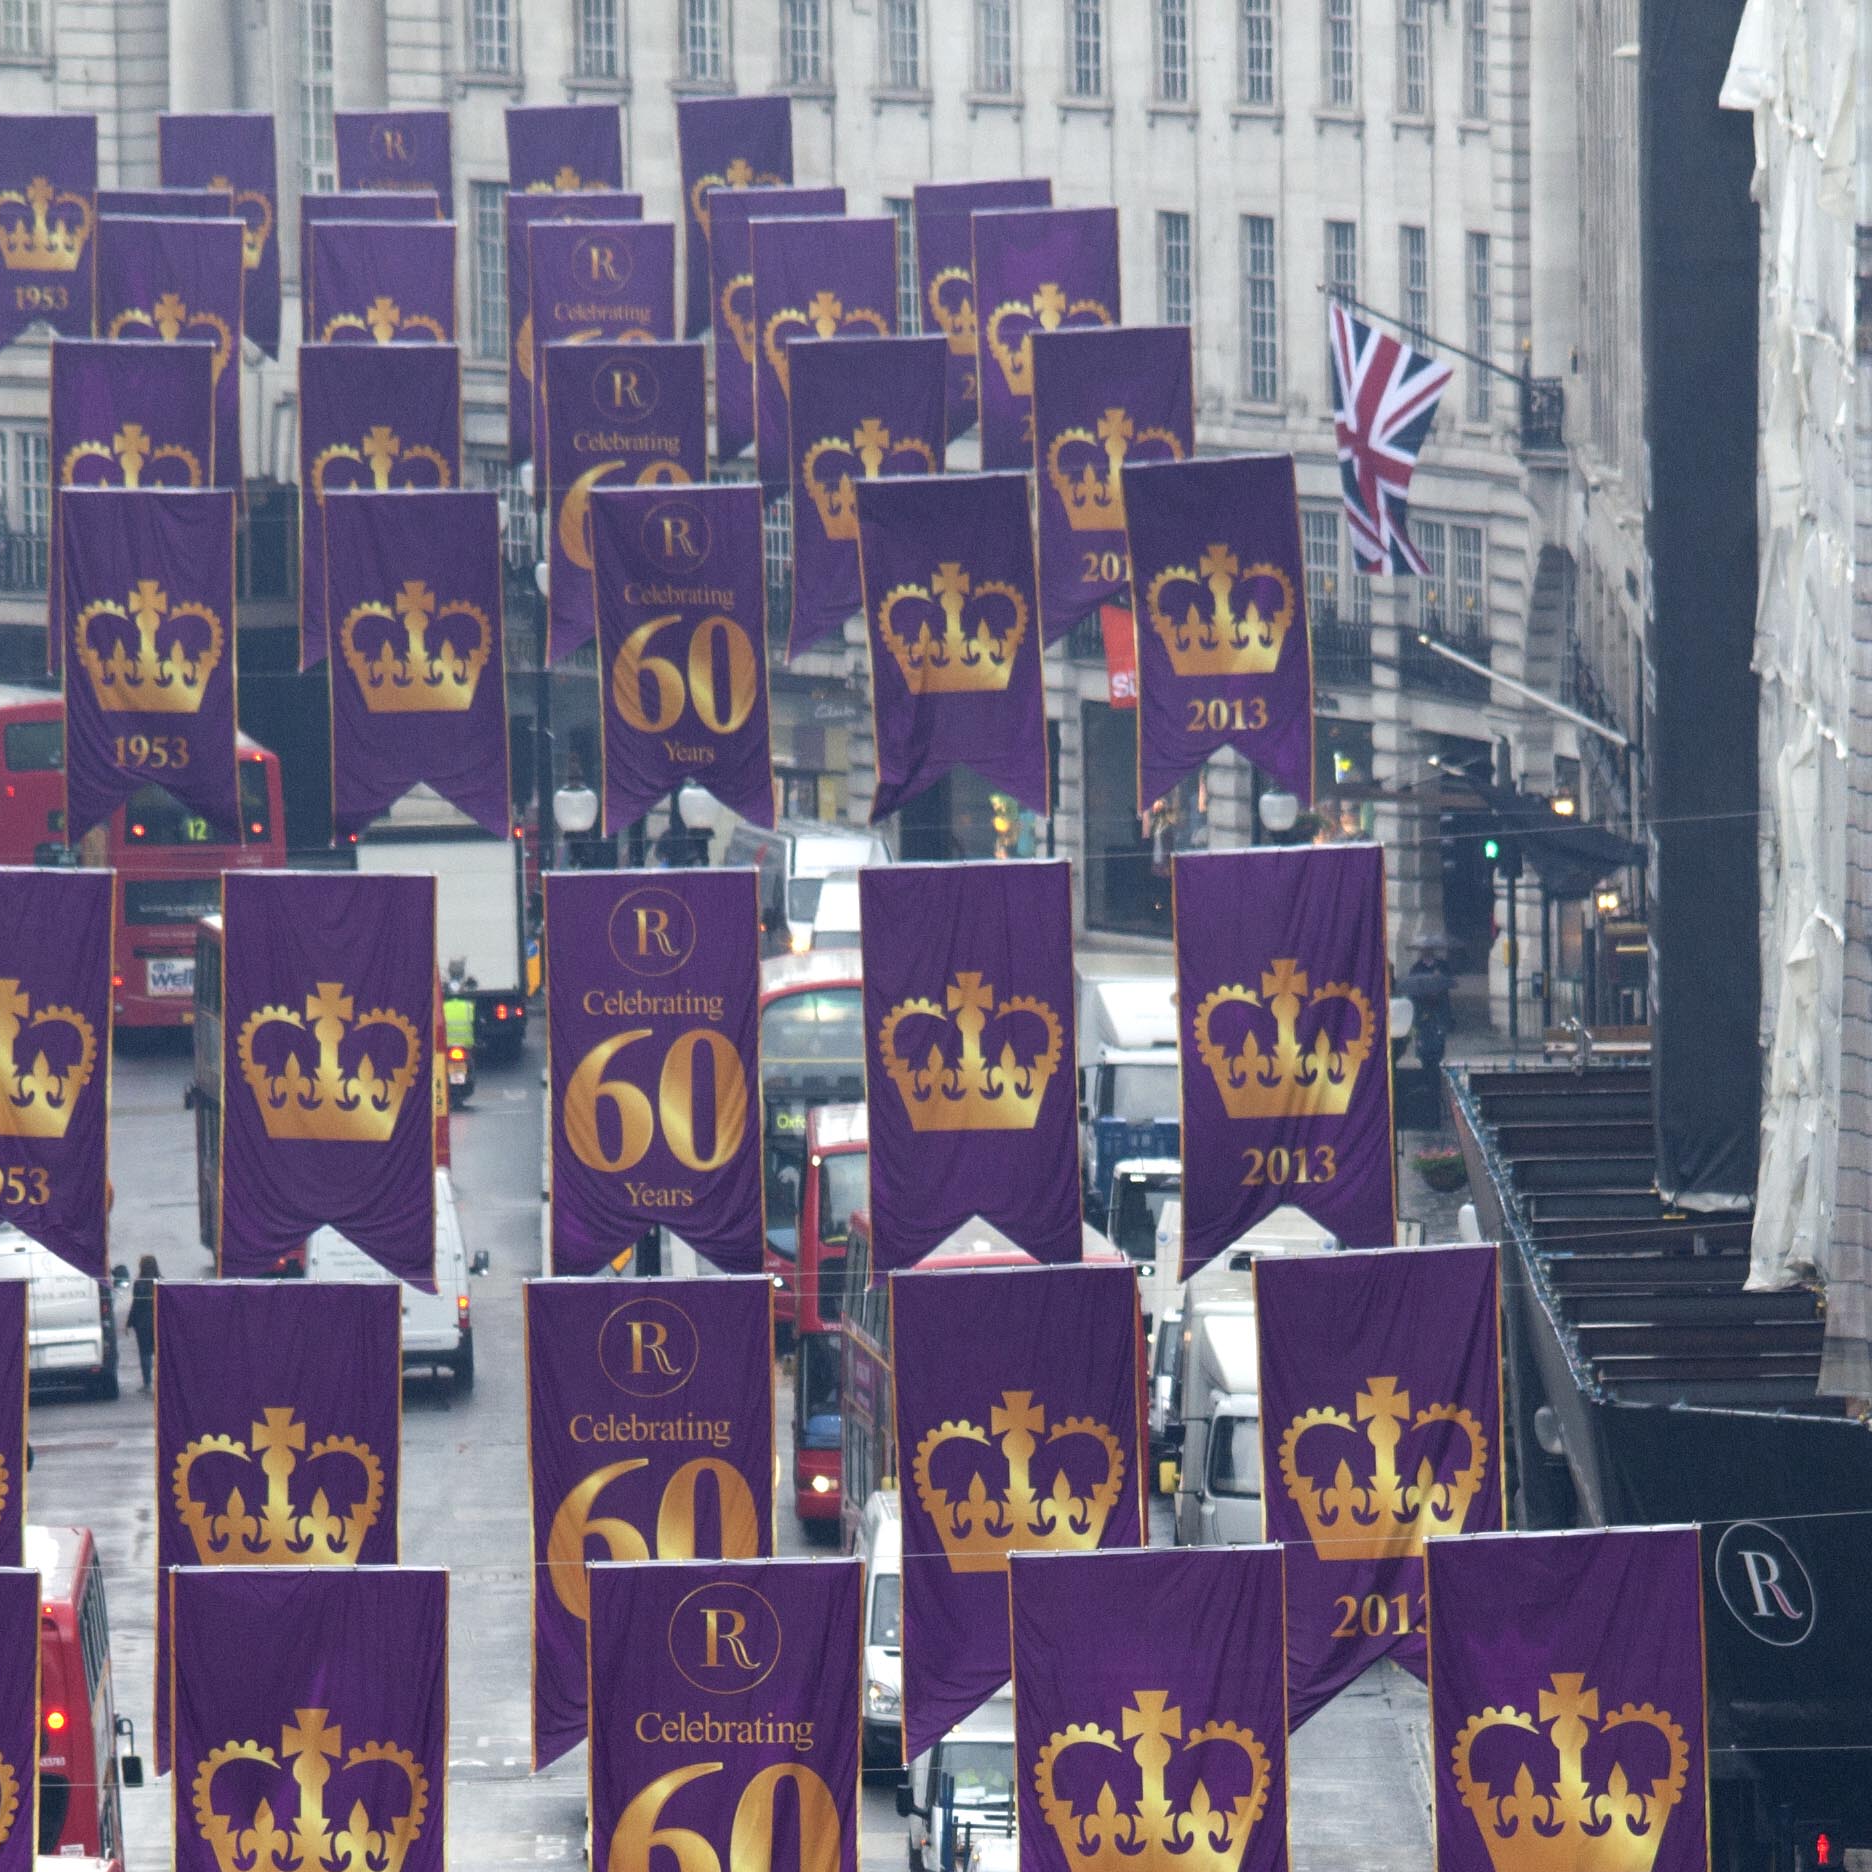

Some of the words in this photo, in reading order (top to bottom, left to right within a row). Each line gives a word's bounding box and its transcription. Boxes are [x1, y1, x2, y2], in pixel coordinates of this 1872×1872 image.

[16, 288, 68, 309] 1953
[611, 371, 642, 404] R
[573, 432, 680, 455] Celebrating
[661, 518, 697, 558] R
[624, 585, 734, 611] Celebrating
[612, 616, 757, 734] 60
[1189, 699, 1268, 731] 2013
[116, 736, 188, 767] 1953
[663, 740, 715, 761] Years
[188, 819, 207, 841] 12
[637, 908, 681, 956] R
[583, 991, 723, 1021] Celebrating
[564, 1029, 747, 1172] 60
[1243, 1145, 1336, 1184] 2013
[625, 1183, 694, 1206] Years
[626, 1322, 681, 1375] R
[569, 1412, 730, 1447] Celebrating
[1737, 1551, 1803, 1619] R
[700, 1609, 761, 1669] R
[635, 1712, 813, 1751] Celebrating
